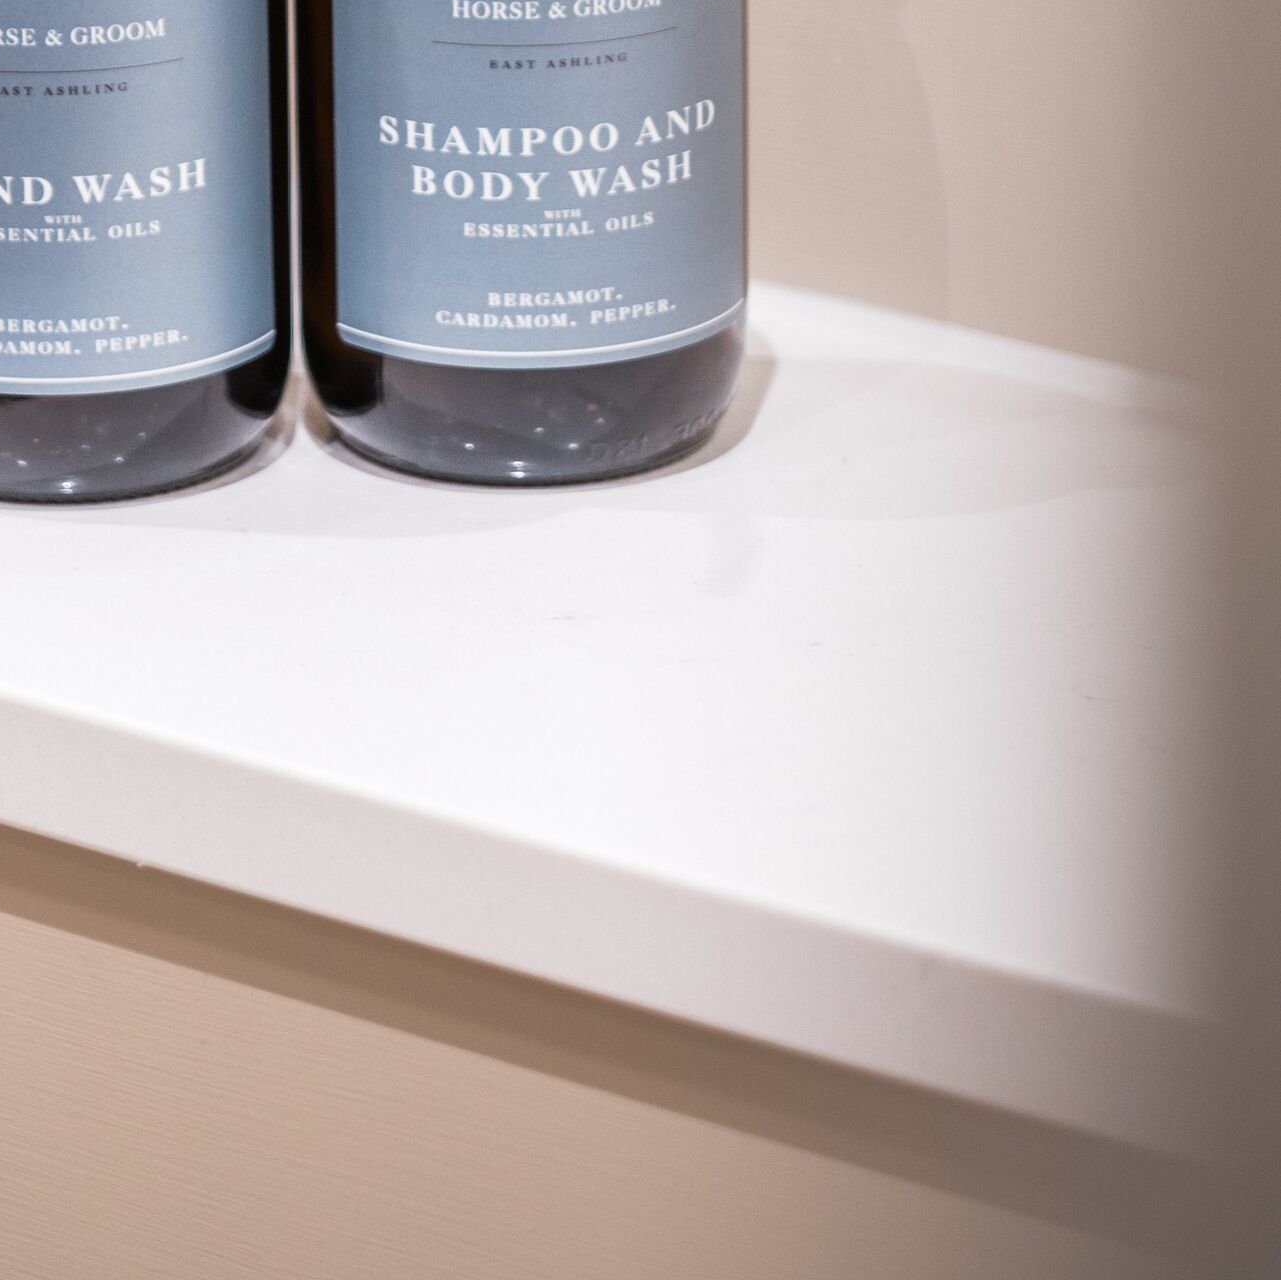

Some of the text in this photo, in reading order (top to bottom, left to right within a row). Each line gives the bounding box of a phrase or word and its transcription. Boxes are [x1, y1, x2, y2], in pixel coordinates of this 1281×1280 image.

[547, 0, 568, 20] &
[43, 27, 64, 47] &
[70, 18, 166, 46] GROOM
[489, 52, 628, 70] EAST ASHLING
[43, 81, 129, 96] ASHLING
[379, 98, 717, 157] SHAMPOO AND
[72, 158, 207, 204] WASH
[411, 149, 693, 201] BODY WASH
[44, 214, 83, 224] WITH
[463, 211, 655, 238] ESSENTIAL OILS
[544, 208, 581, 219] WITH
[108, 219, 161, 239] OILS
[487, 286, 623, 308] BERGAMOT.
[436, 298, 677, 328] CARDAMOM. PEPPER.
[95, 329, 188, 354] PEPPER.
